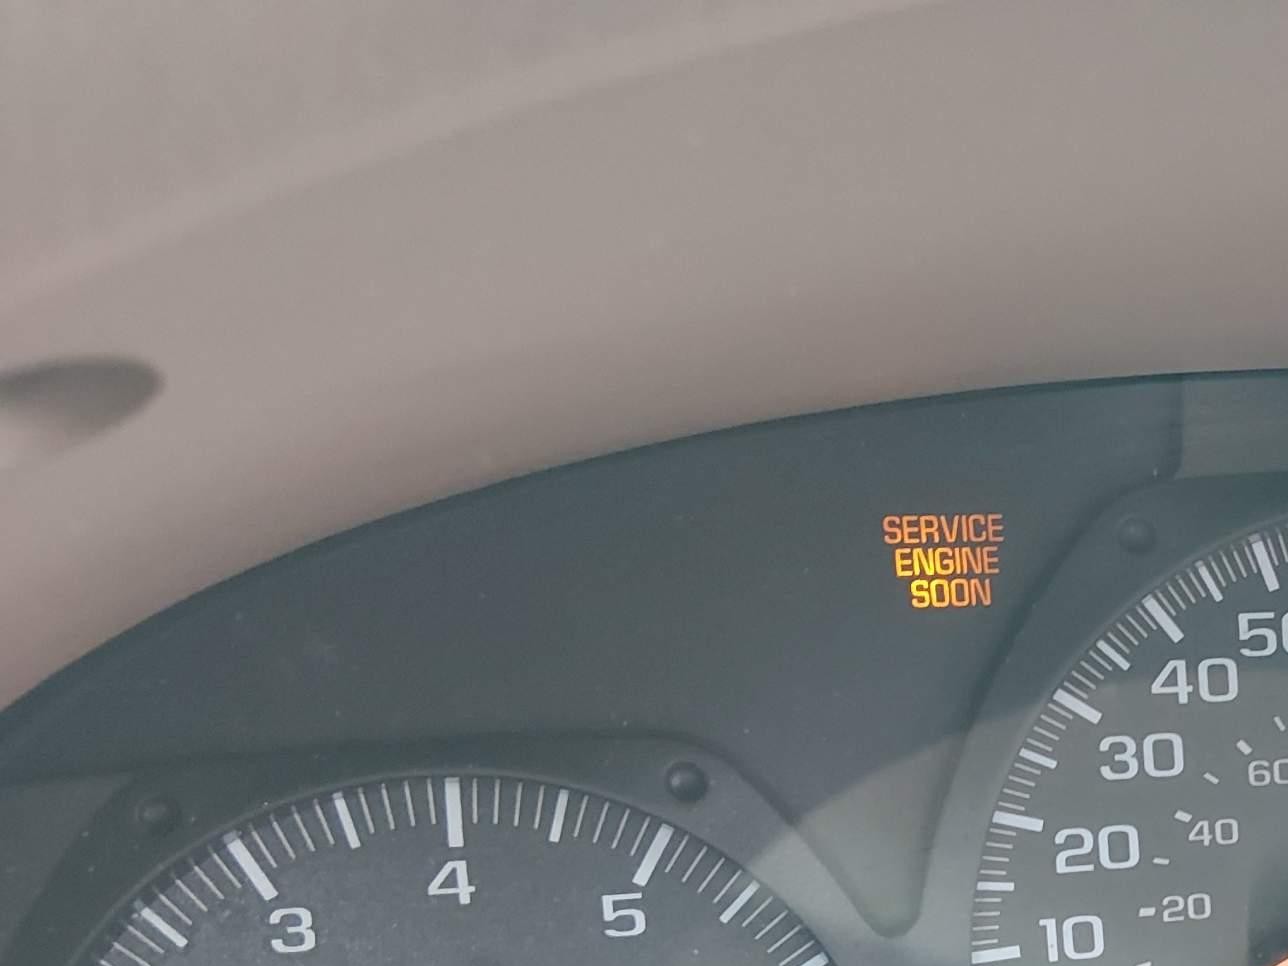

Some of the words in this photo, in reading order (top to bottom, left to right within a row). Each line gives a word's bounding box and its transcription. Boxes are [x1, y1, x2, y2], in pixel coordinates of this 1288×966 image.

[883, 515, 1003, 544] SERVICE
[896, 547, 998, 576] ENGINE
[911, 579, 990, 607] SOON
[1152, 658, 1238, 704] 40
[1100, 733, 1183, 780] 30
[1055, 825, 1139, 873] 20
[1189, 819, 1238, 846] 40
[428, 861, 475, 904] 4
[602, 893, 645, 936] 5
[1163, 894, 1211, 922] 20
[270, 908, 315, 952] 3
[1039, 916, 1104, 962] 10
